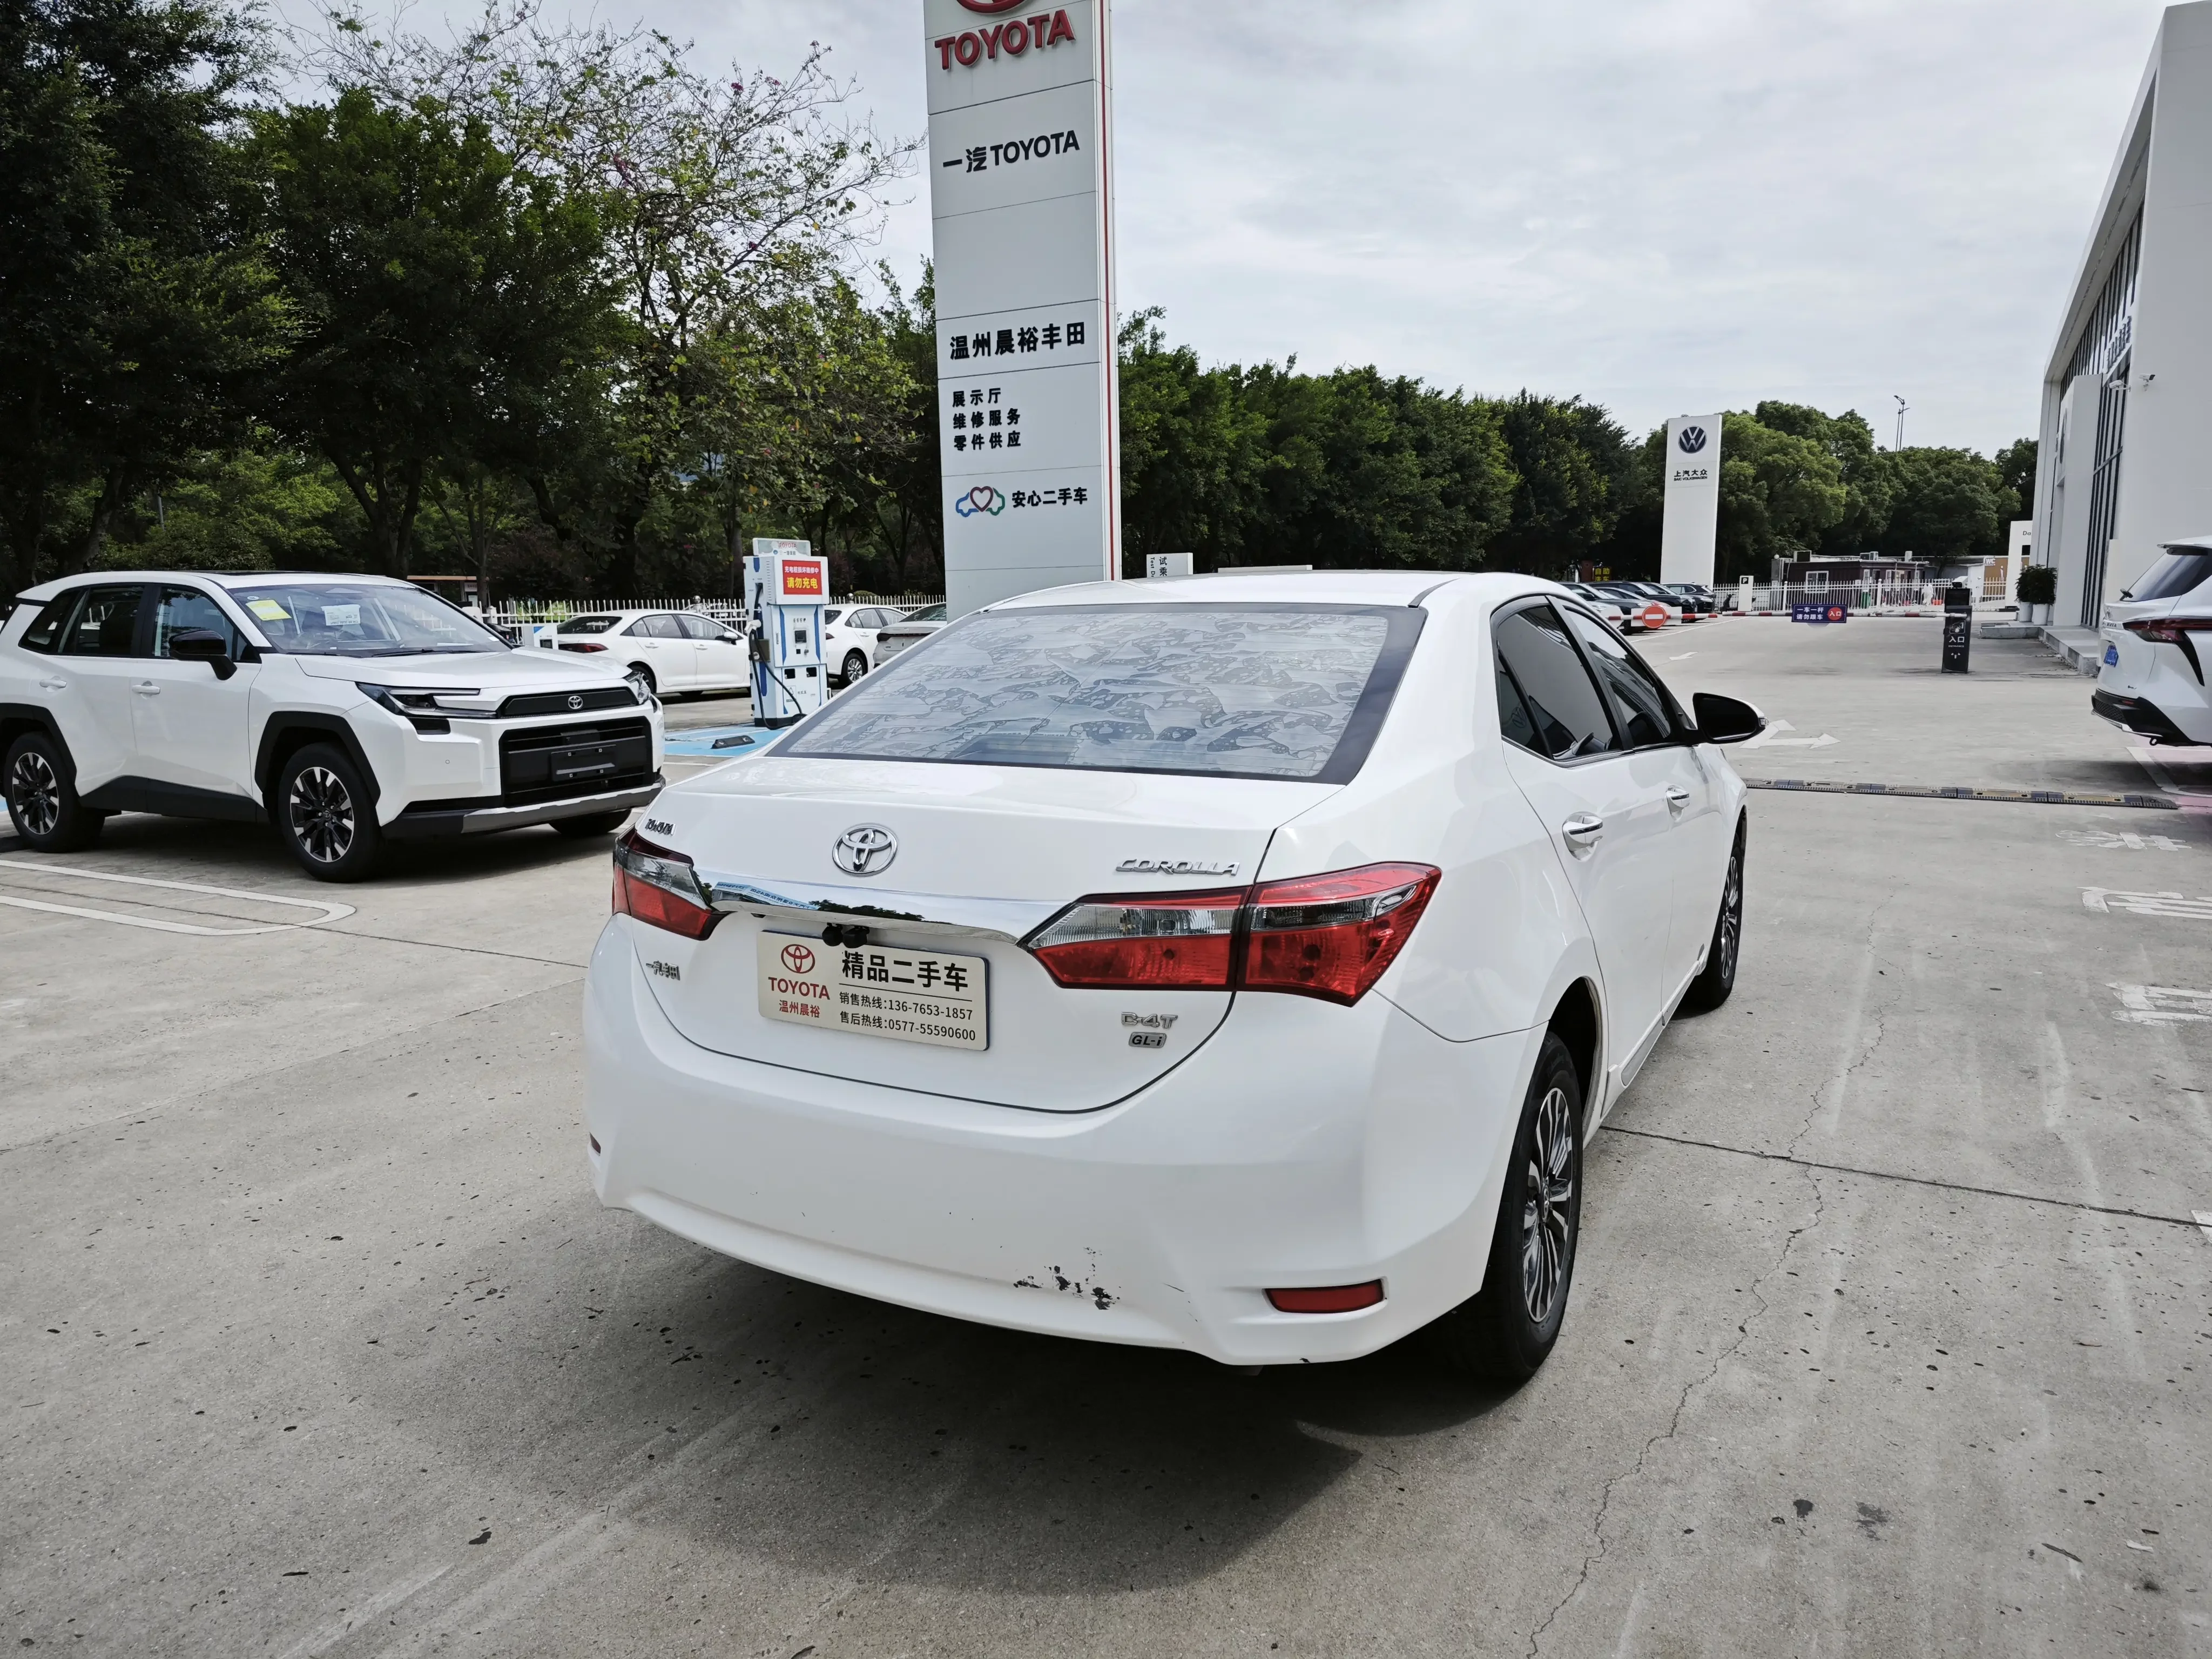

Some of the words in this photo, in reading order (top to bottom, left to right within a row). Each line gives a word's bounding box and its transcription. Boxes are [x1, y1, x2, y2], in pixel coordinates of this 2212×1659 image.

[934, 9, 1076, 70] TOYOTA
[949, 322, 1085, 360] 温州晨裕丰田
[952, 388, 1001, 407] 展示厅
[953, 408, 1021, 429] 维修服务
[954, 430, 1021, 451] 零件供应
[1674, 469, 1708, 477] 上汽大众
[1011, 487, 1088, 508] 安心二手车
[1159, 556, 1168, 577] 试乘
[786, 577, 818, 589] 请勿充电
[645, 819, 676, 835] TOYOTA
[1115, 859, 1240, 876] COROLLA
[841, 950, 968, 992] 精品二手车
[768, 976, 830, 1001] TOYOTA
[779, 999, 820, 1019] 温州晨裕
[1131, 1035, 1163, 1047] GL-i
